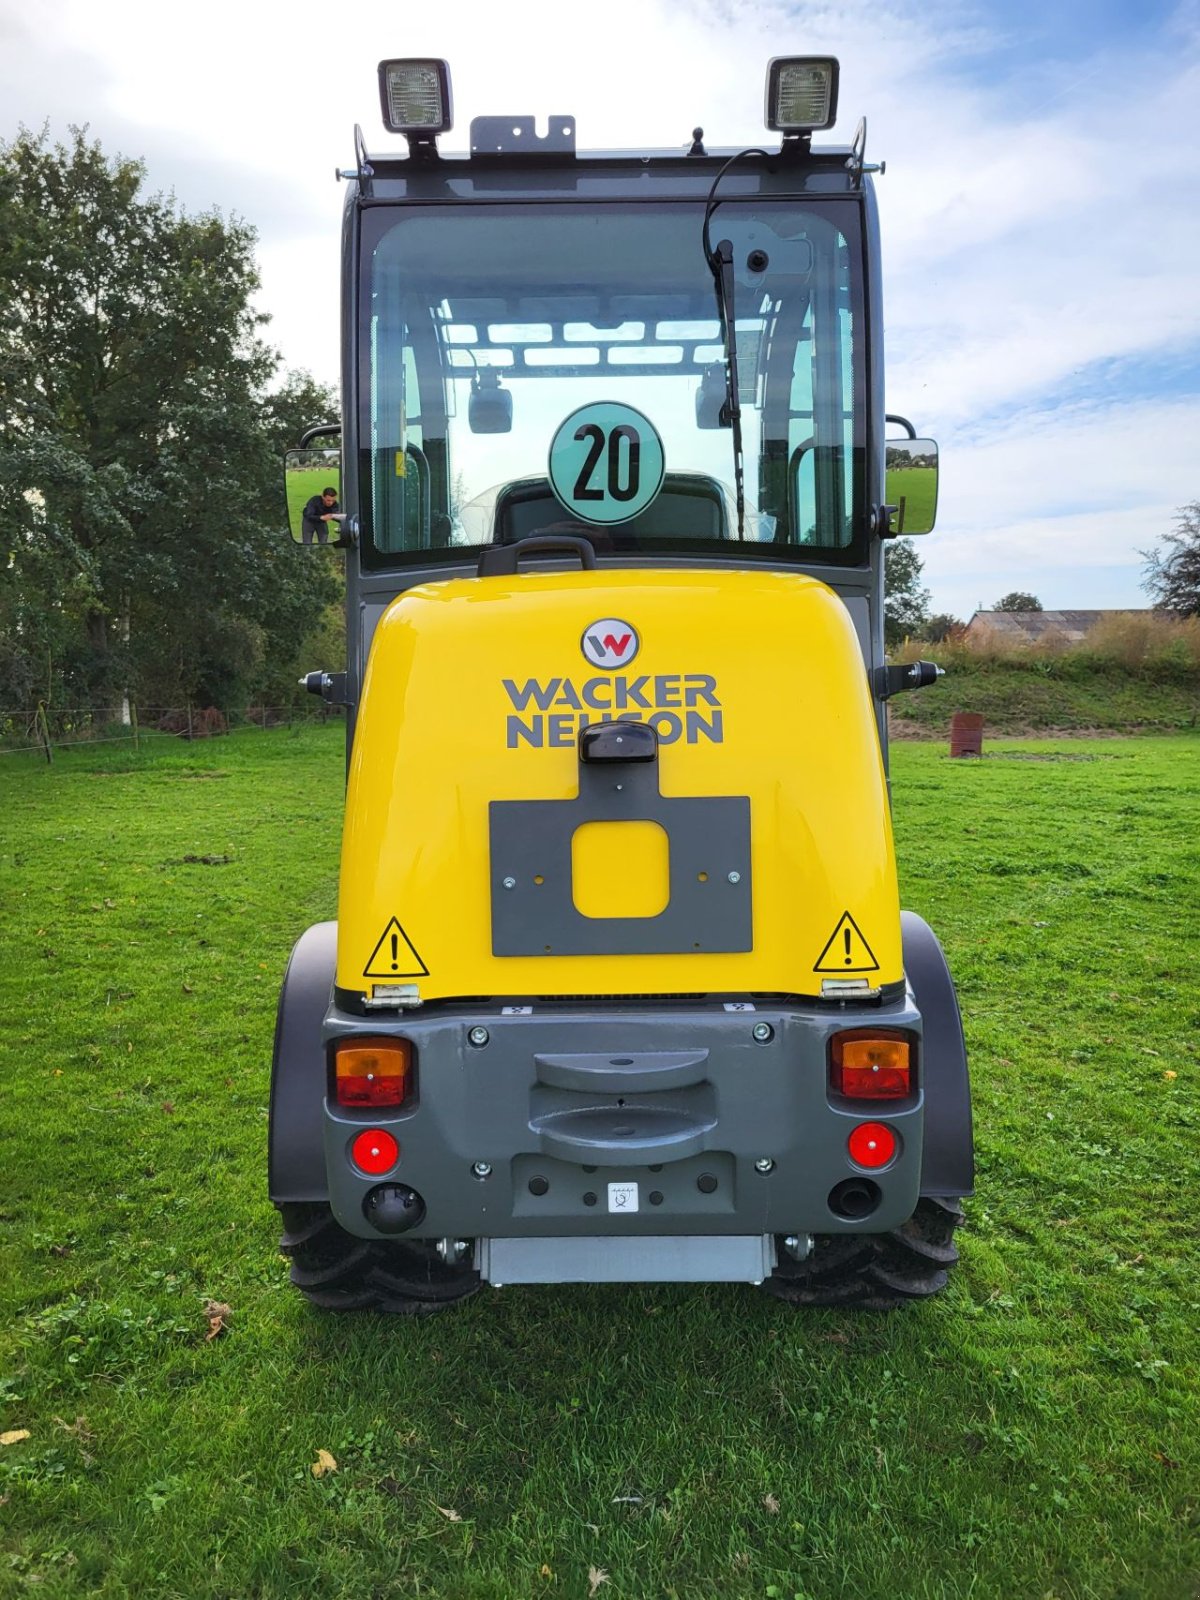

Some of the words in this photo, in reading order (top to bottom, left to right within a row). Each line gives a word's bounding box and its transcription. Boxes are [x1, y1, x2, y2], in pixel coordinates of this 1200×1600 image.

[573, 423, 640, 502] 20
[501, 674, 722, 711] WACKER
[506, 710, 724, 748] NEON
